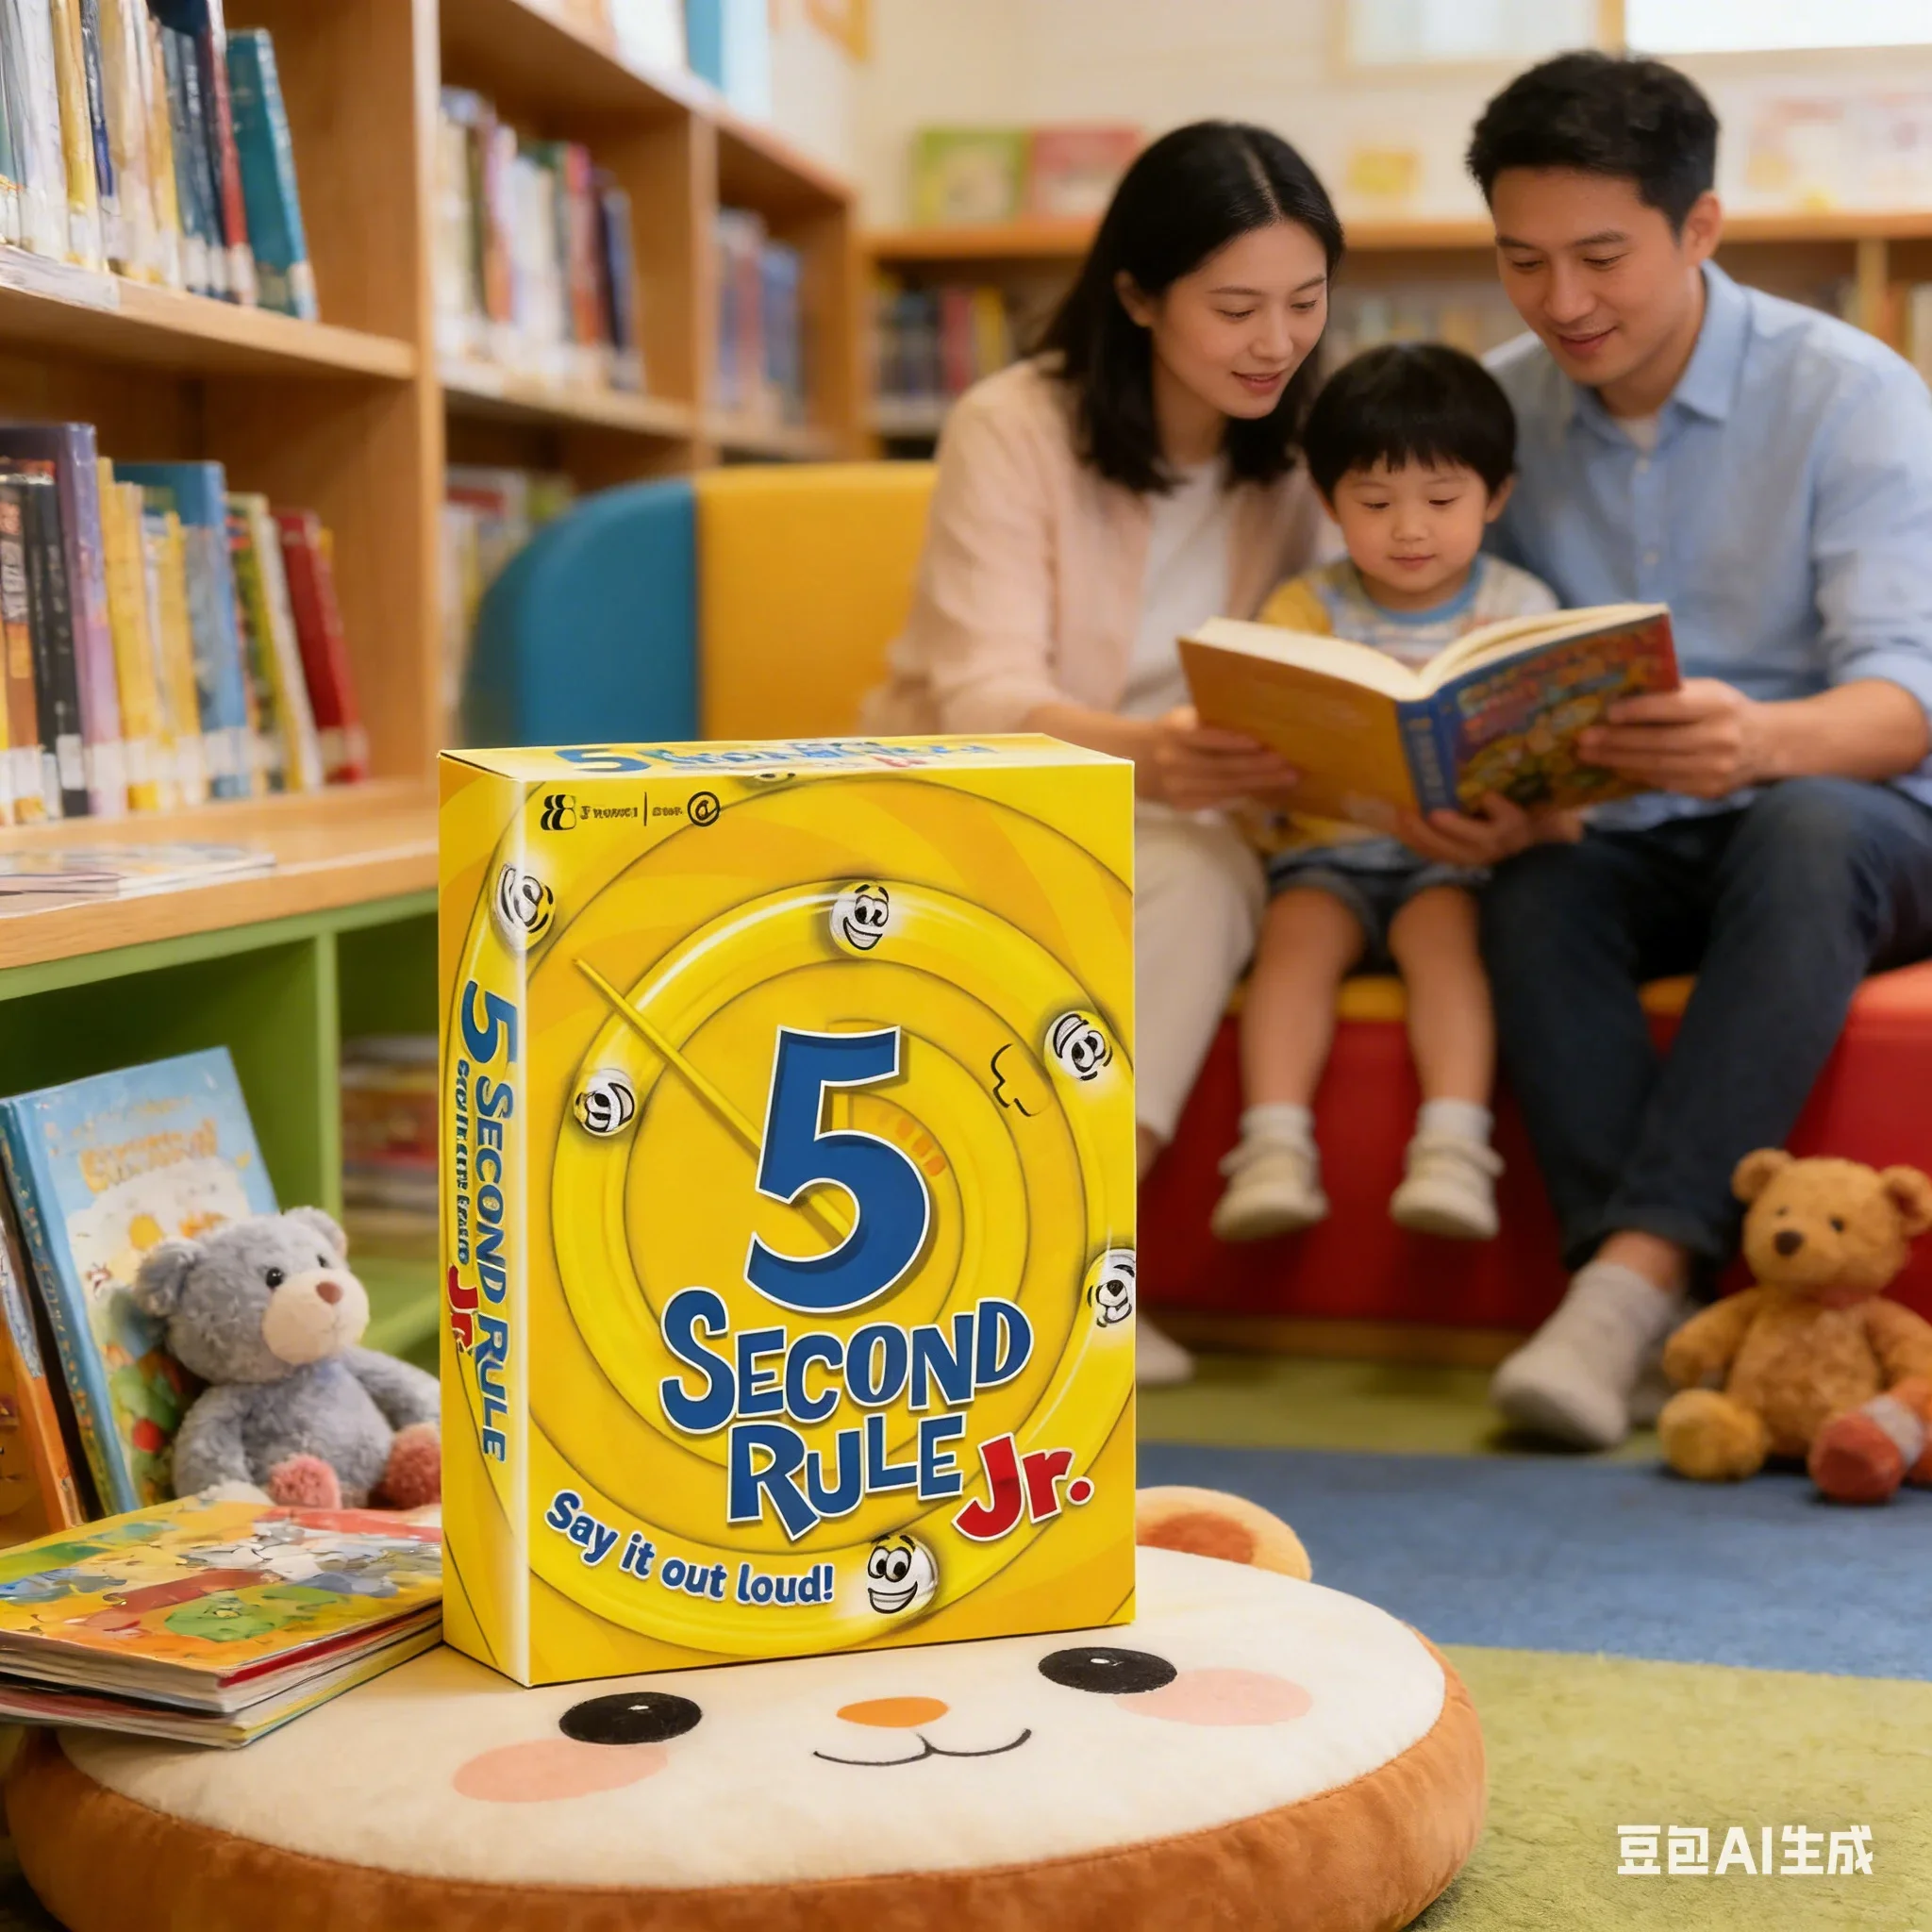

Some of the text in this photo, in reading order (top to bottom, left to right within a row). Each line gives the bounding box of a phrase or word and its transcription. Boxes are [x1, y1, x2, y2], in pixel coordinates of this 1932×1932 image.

[555, 748, 652, 773] 5
[461, 980, 518, 1064] 5
[475, 1074, 514, 1305] SECOND
[742, 1024, 931, 1314] 5
[474, 1311, 509, 1463] RULE
[659, 1286, 1035, 1435] SECOND
[725, 1410, 1095, 1542] RULE Jr.
[543, 1490, 835, 1607] Say it out loud!
